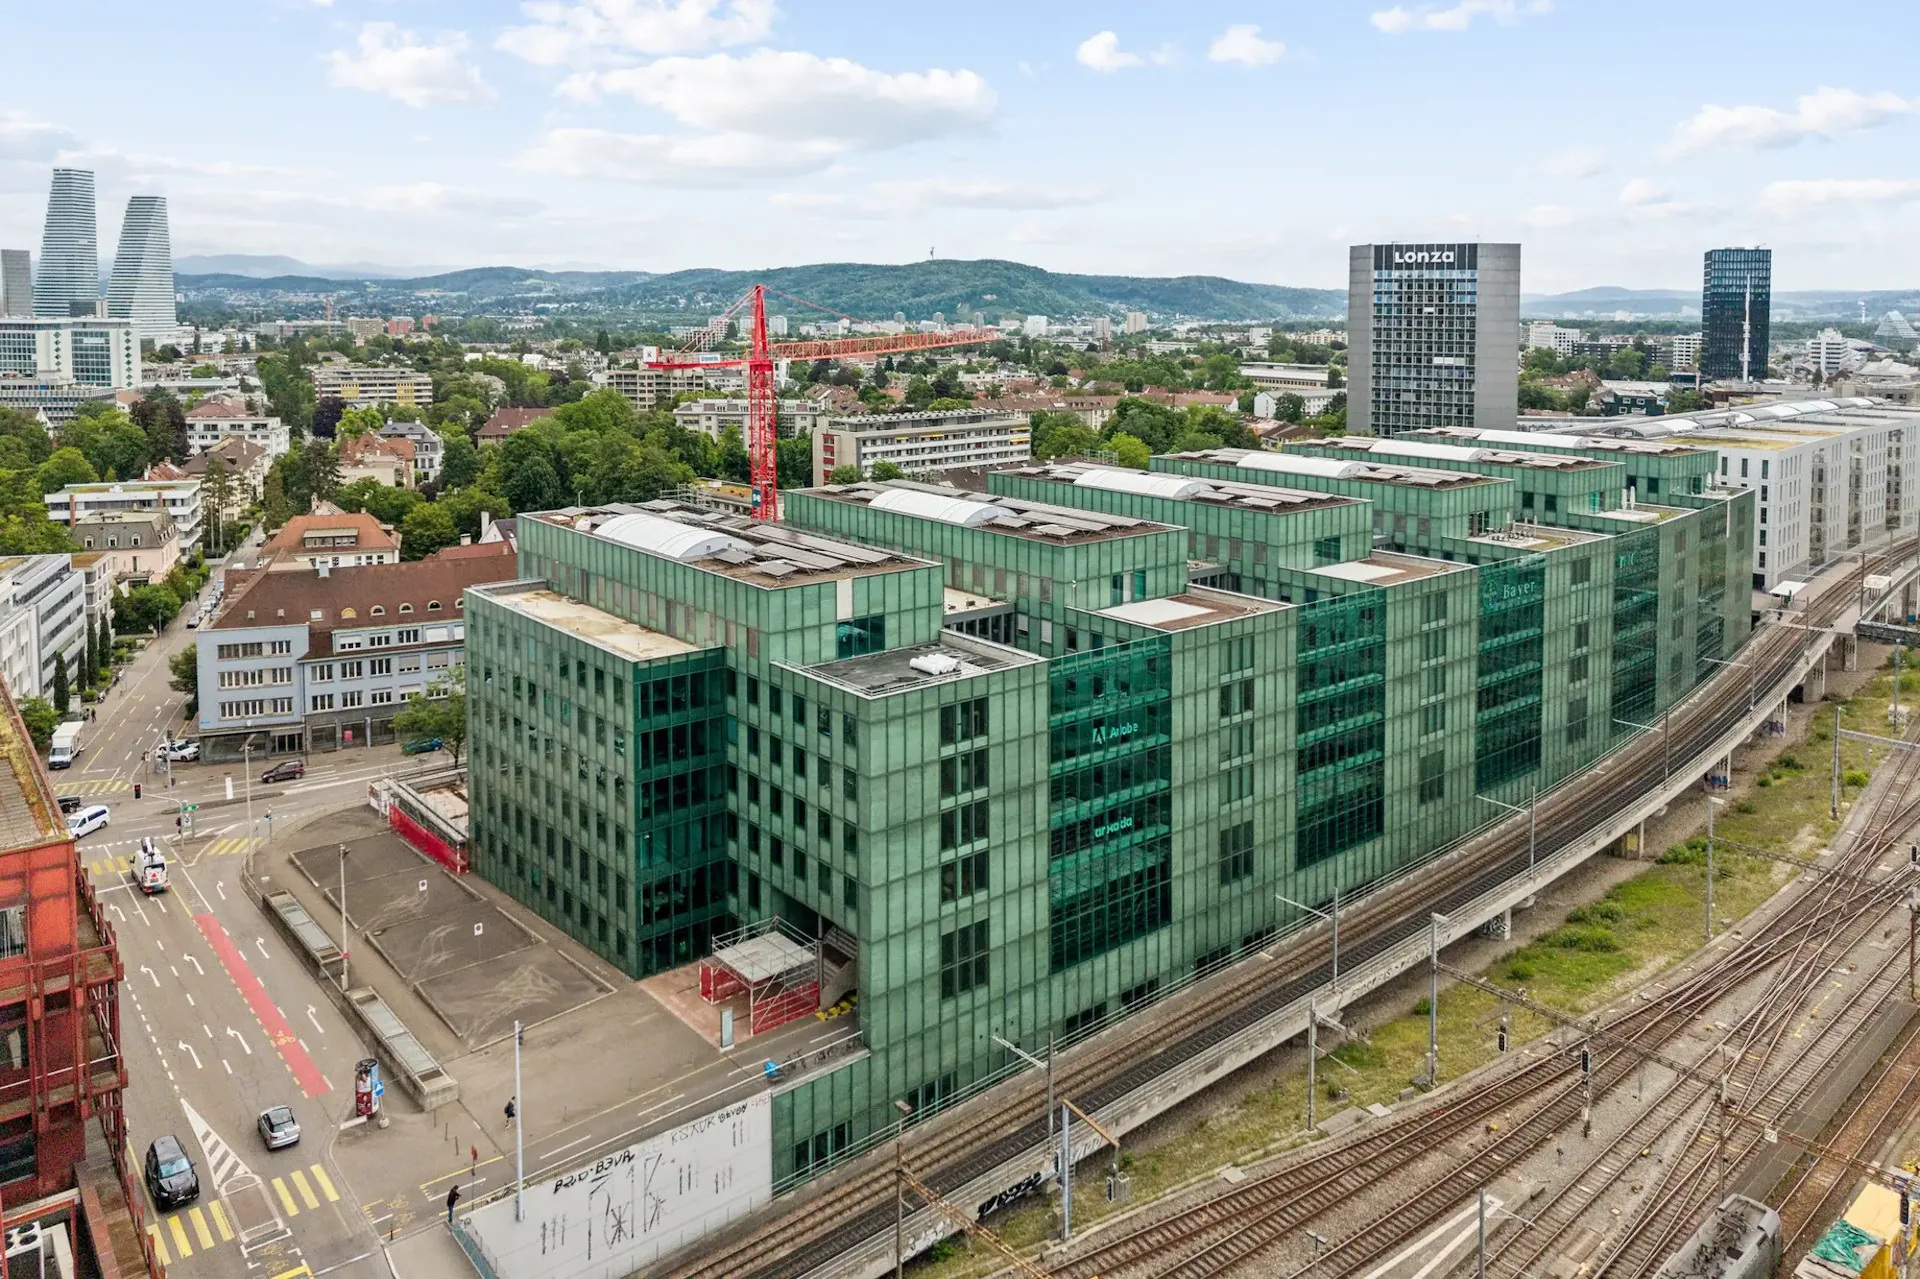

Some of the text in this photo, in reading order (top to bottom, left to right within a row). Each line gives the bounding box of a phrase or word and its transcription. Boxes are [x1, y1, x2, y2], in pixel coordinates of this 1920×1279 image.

[1394, 251, 1455, 263] Lonza
[1503, 581, 1535, 600] Bayer
[1094, 816, 1133, 838] arxada
